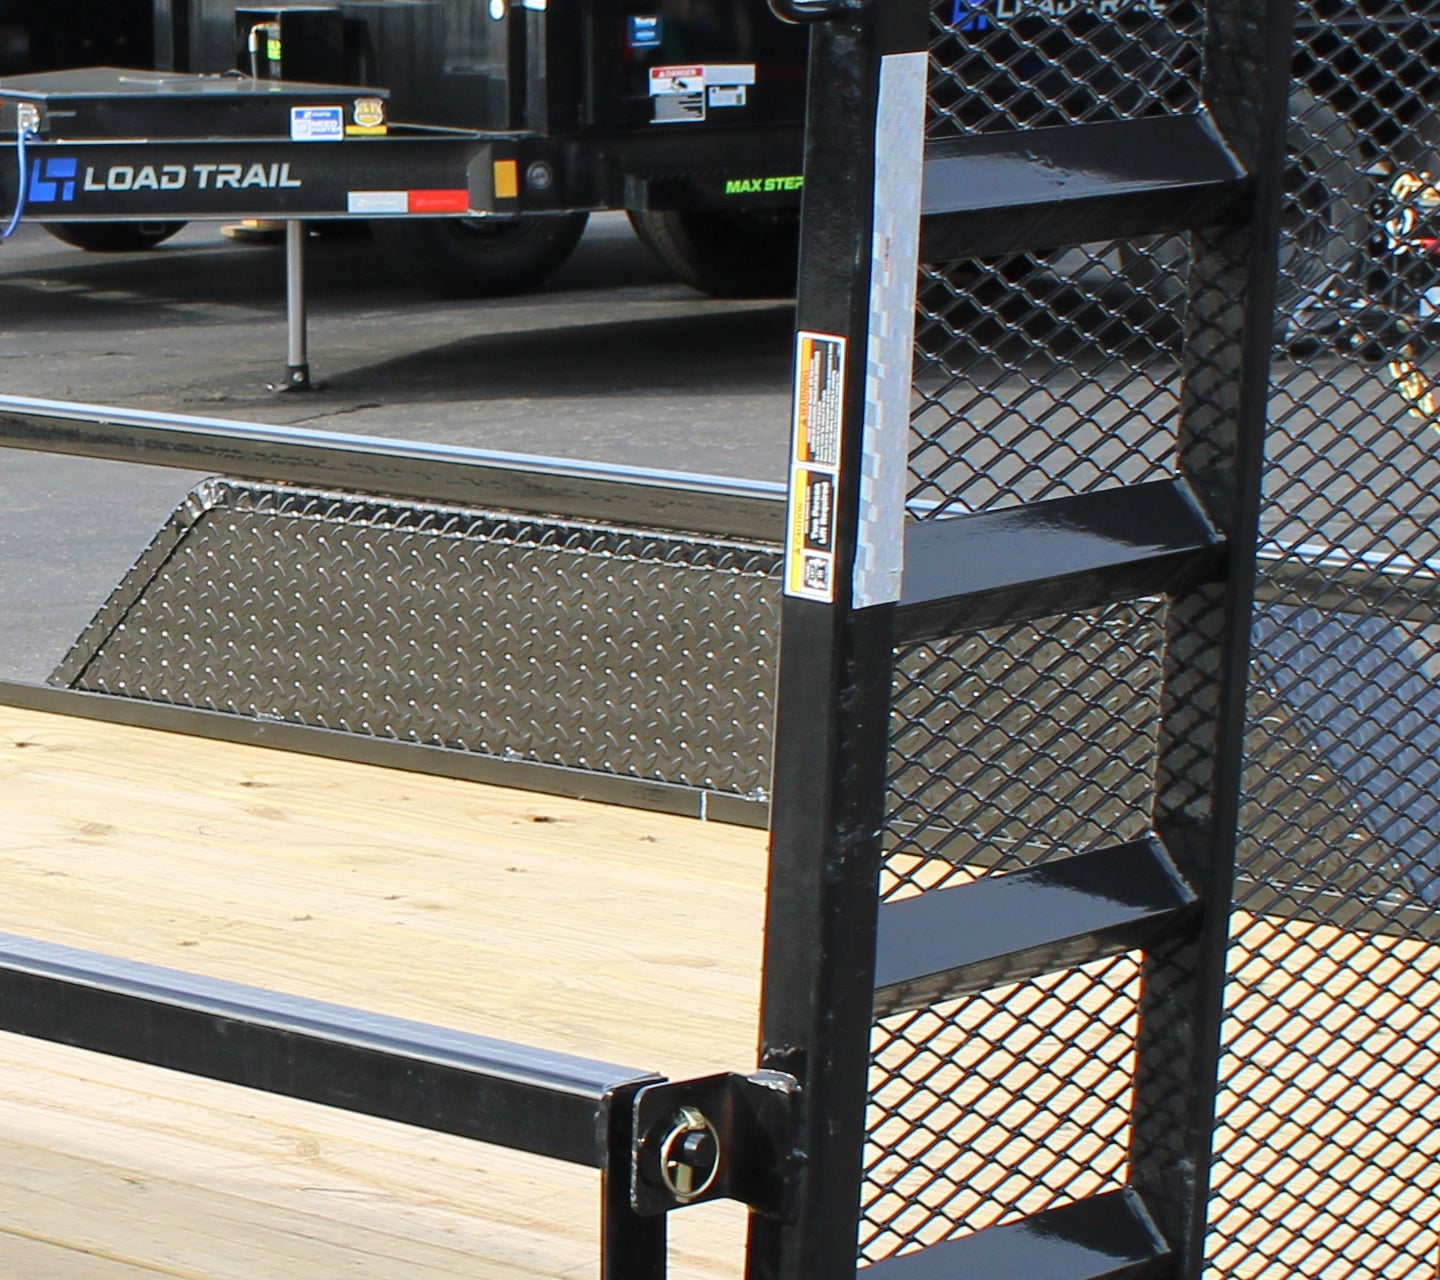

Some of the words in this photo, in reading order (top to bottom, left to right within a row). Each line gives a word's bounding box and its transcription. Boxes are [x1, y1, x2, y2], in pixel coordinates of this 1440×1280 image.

[83, 165, 187, 192] LOAD
[193, 162, 303, 189] TRAIL
[725, 178, 763, 194] MAX
[763, 175, 805, 192] STEP
[799, 370, 809, 417] WARNING
[810, 482, 821, 518] Person
[818, 481, 831, 526] Required
[795, 502, 804, 546] CAUTION
